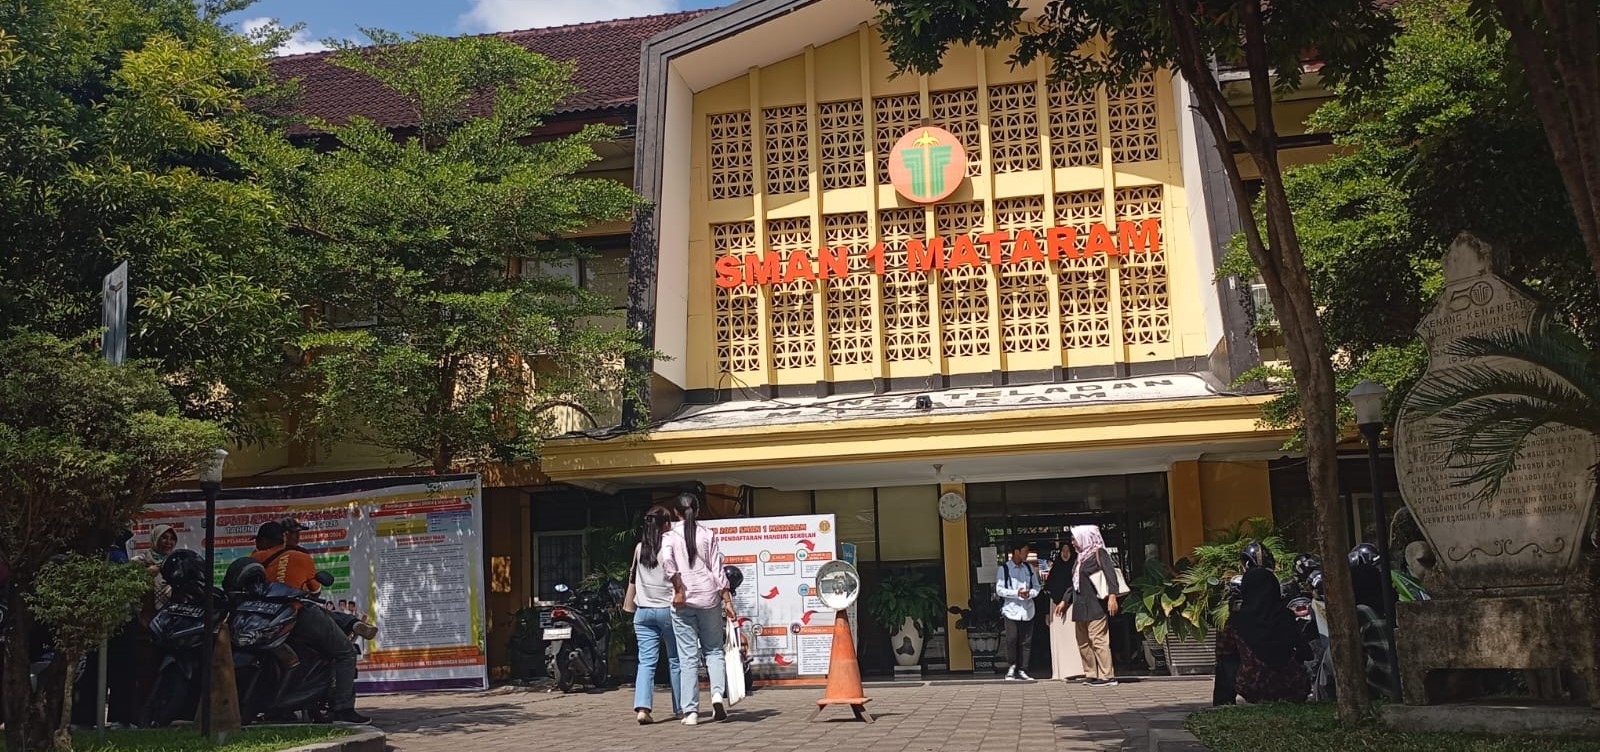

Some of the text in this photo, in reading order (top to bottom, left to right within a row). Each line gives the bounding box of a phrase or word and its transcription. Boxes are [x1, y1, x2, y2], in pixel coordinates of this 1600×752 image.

[715, 217, 1162, 288] SMAN 1 MATARAM
[944, 380, 1174, 399] TELADAN
[720, 534, 762, 542] PENDAFTARAN
